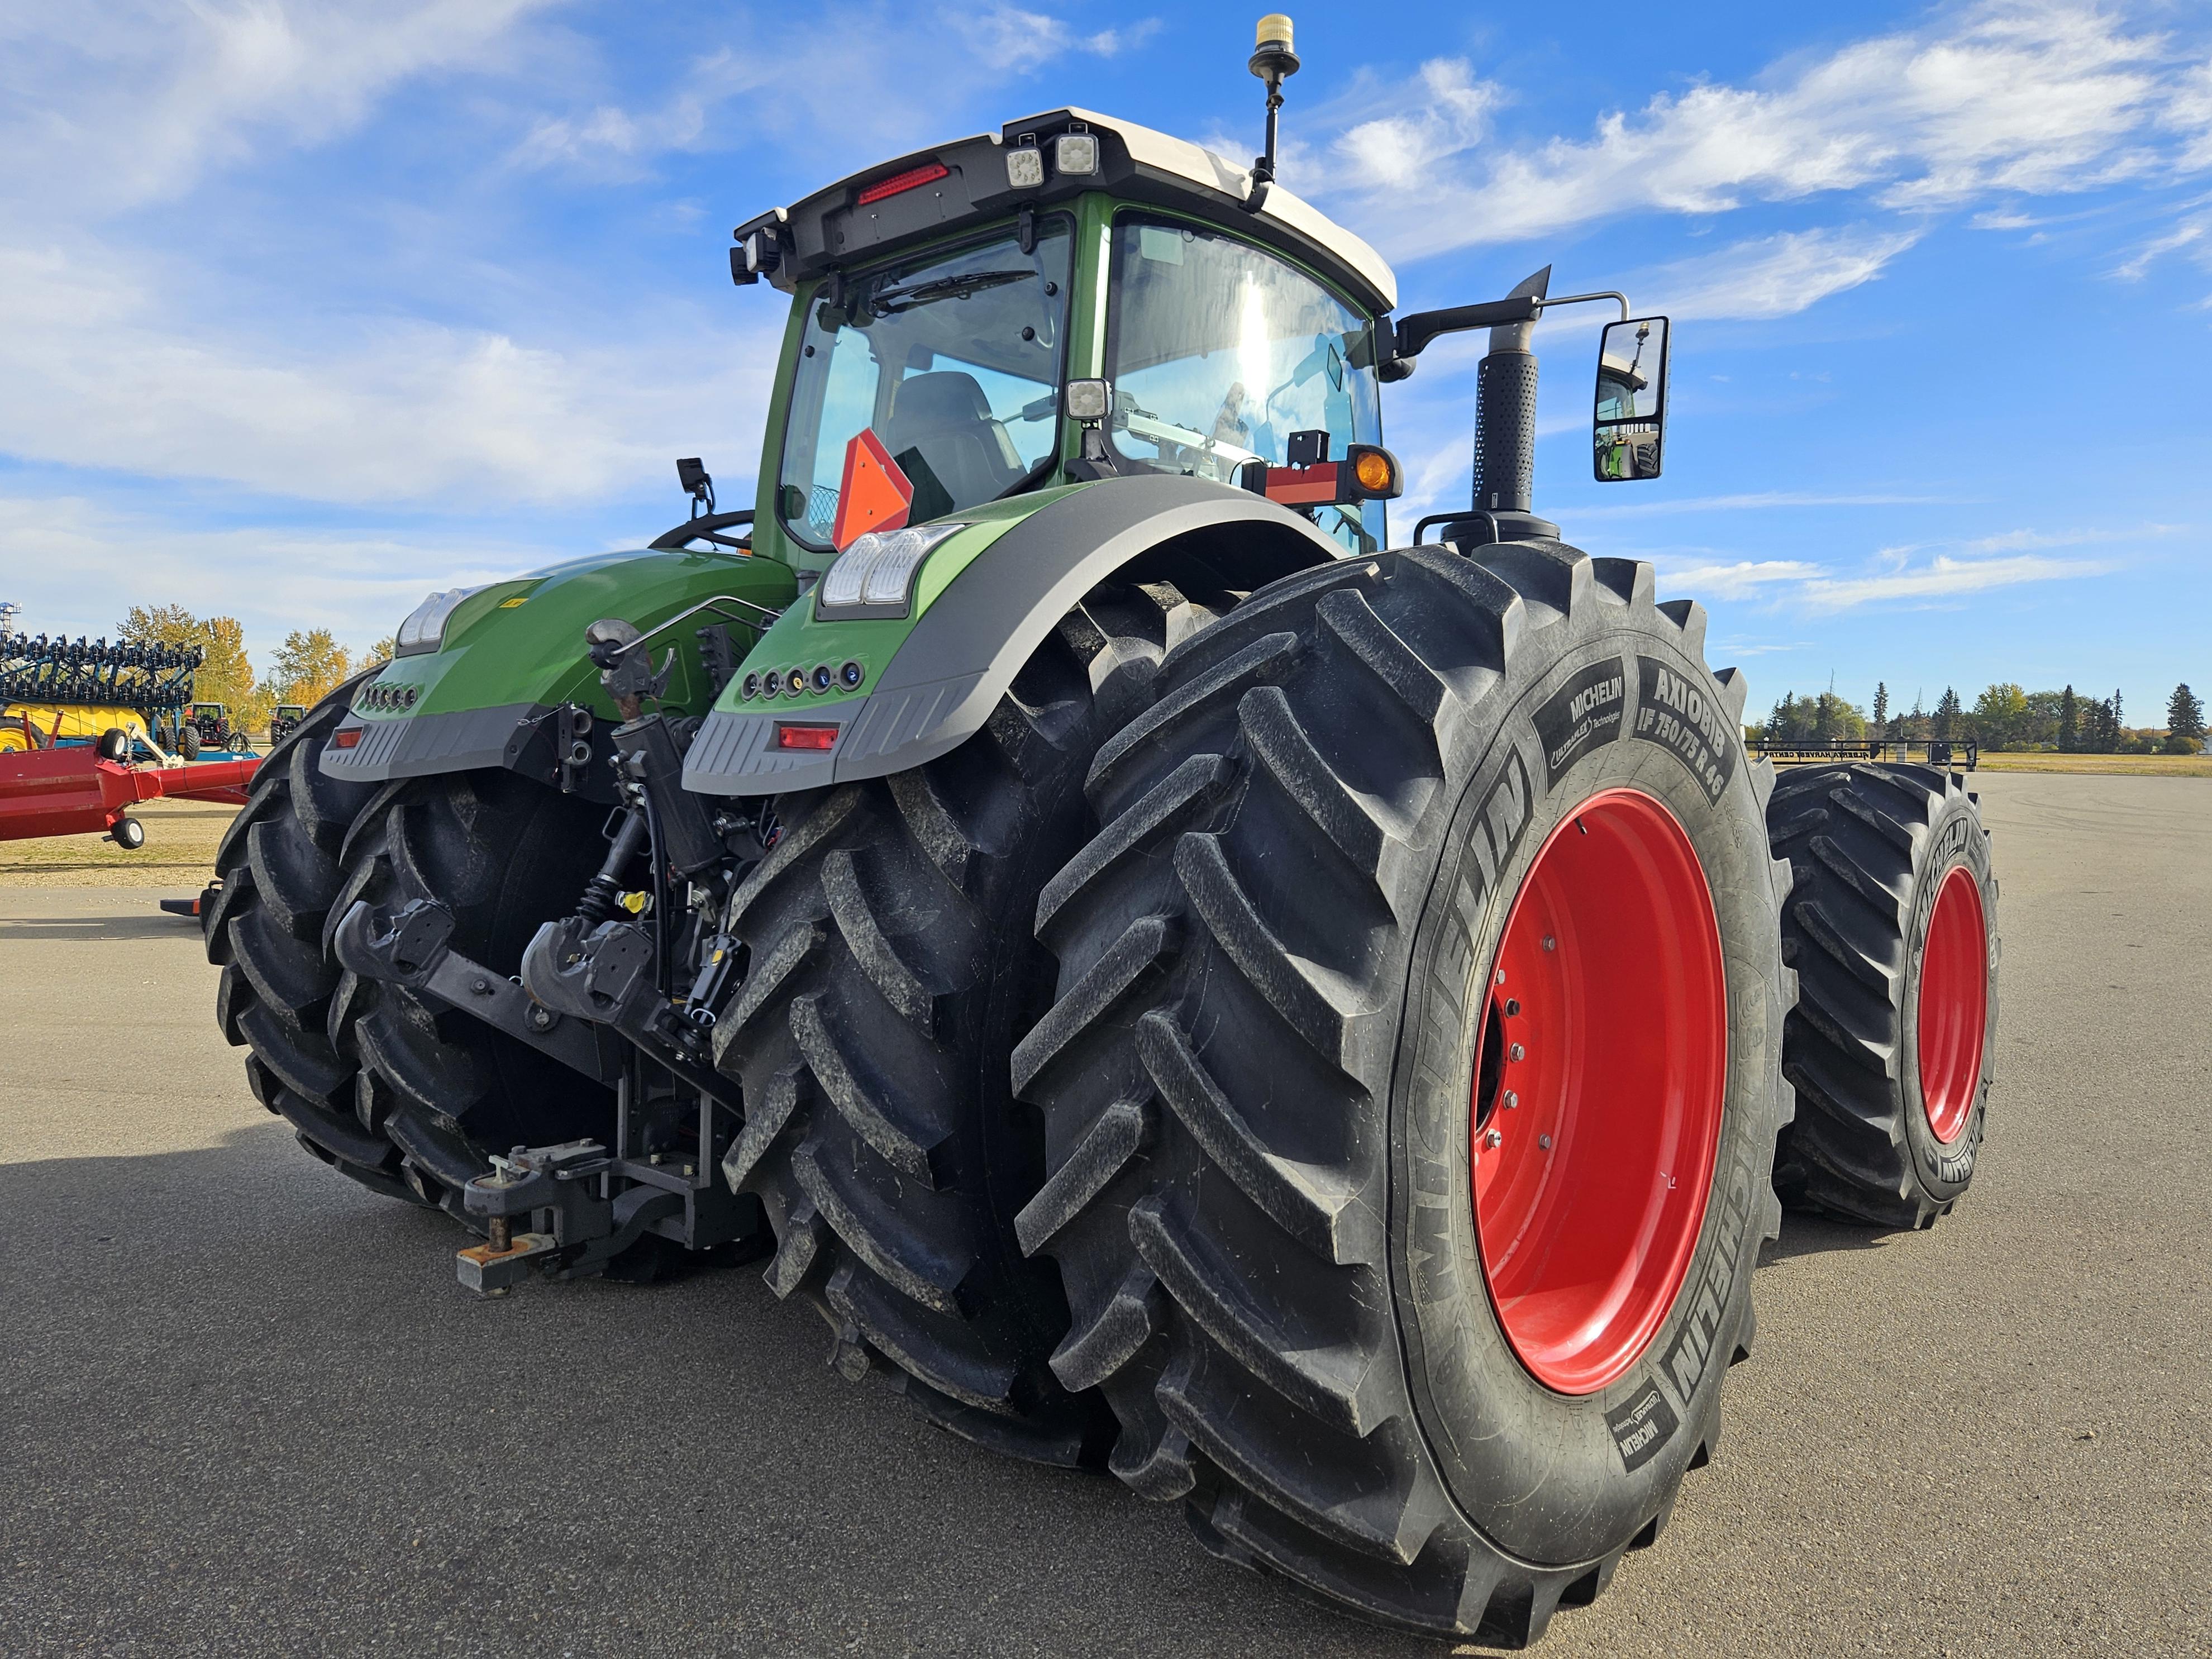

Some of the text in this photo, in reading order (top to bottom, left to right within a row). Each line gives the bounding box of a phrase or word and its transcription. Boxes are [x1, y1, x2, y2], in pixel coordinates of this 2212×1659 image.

[1556, 711, 1620, 762] ULTRAFLEX Technologies
[1570, 676, 1622, 723] MICHELIN
[1654, 668, 1725, 758] AXIOBIB
[1637, 708, 1724, 795] IF 750/75 R 46
[1919, 819, 1967, 941] MICHELIN
[1415, 758, 1525, 1305] MICHELIN
[1619, 1419, 1658, 1457] MICHELIN
